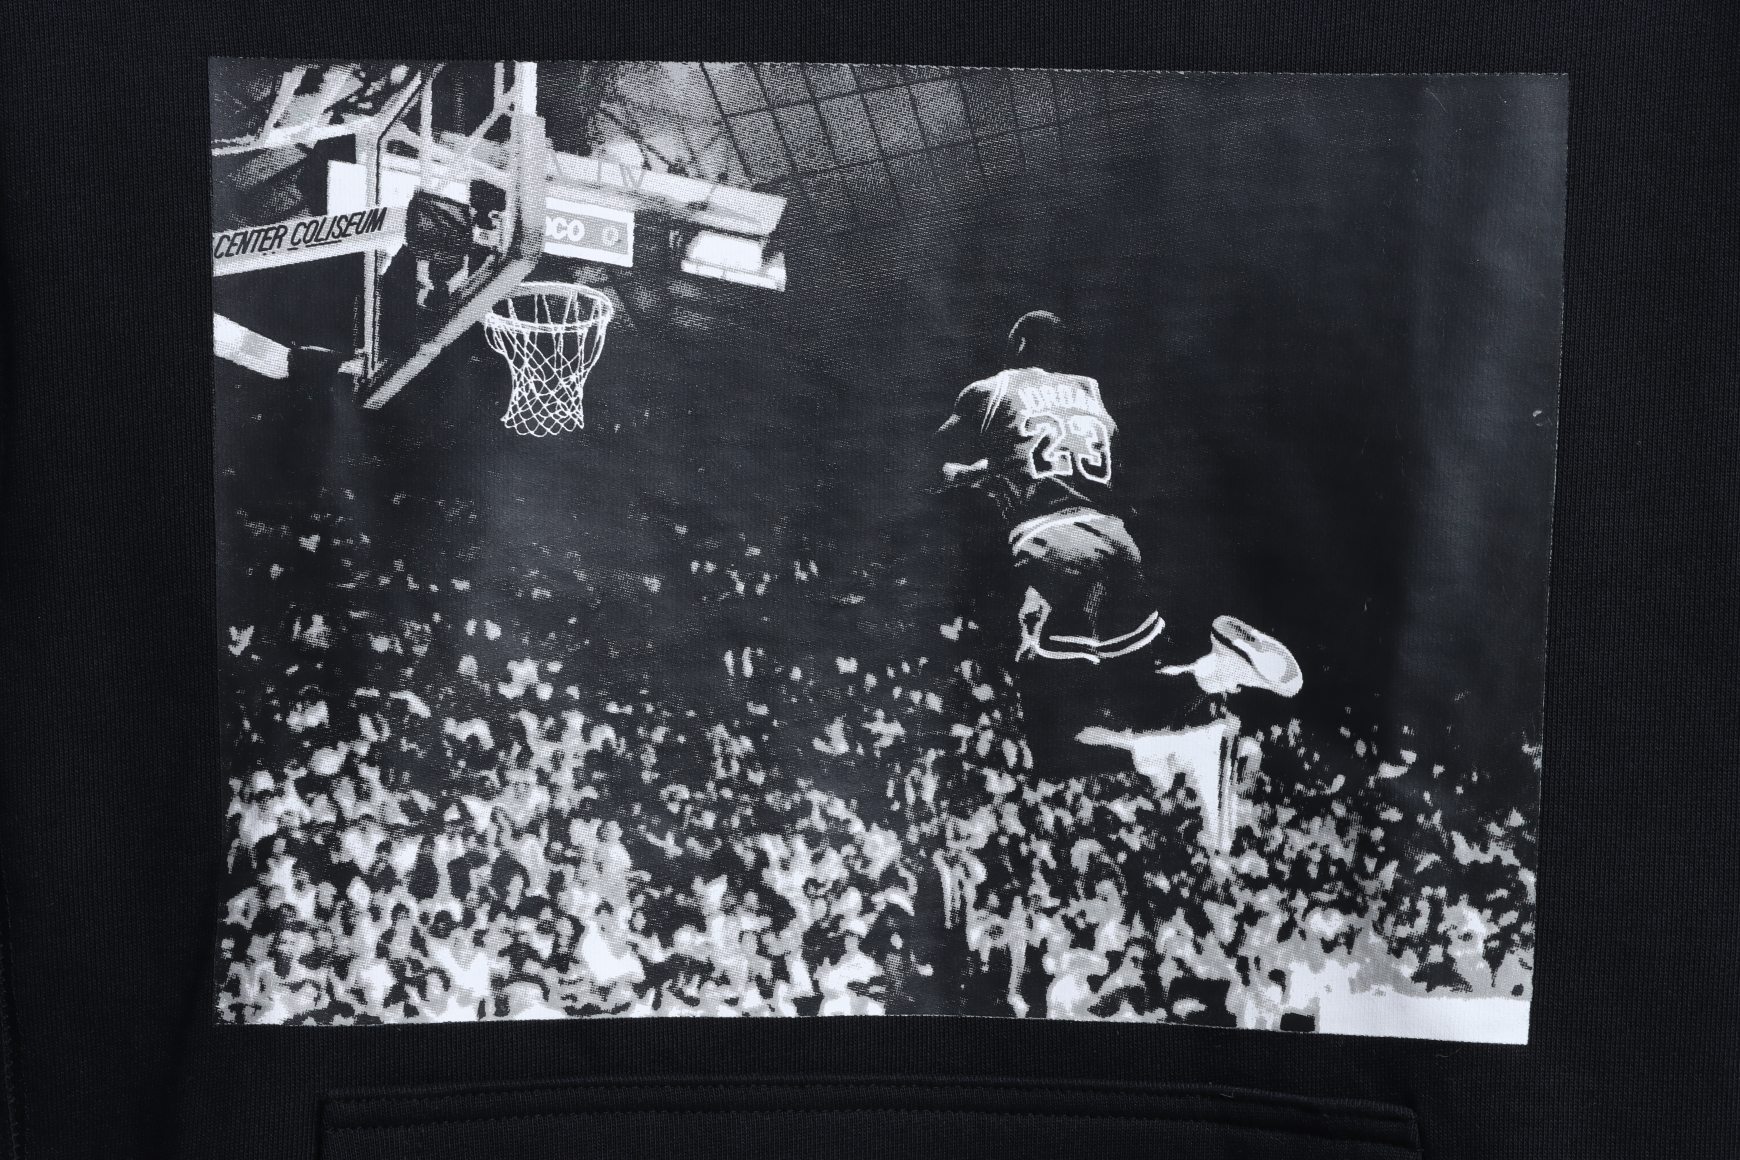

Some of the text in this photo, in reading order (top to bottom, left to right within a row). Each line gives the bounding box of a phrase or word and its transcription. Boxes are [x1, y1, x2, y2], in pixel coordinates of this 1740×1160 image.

[213, 206, 388, 259] CENTER COLISEUM
[1020, 412, 1112, 484] 23
